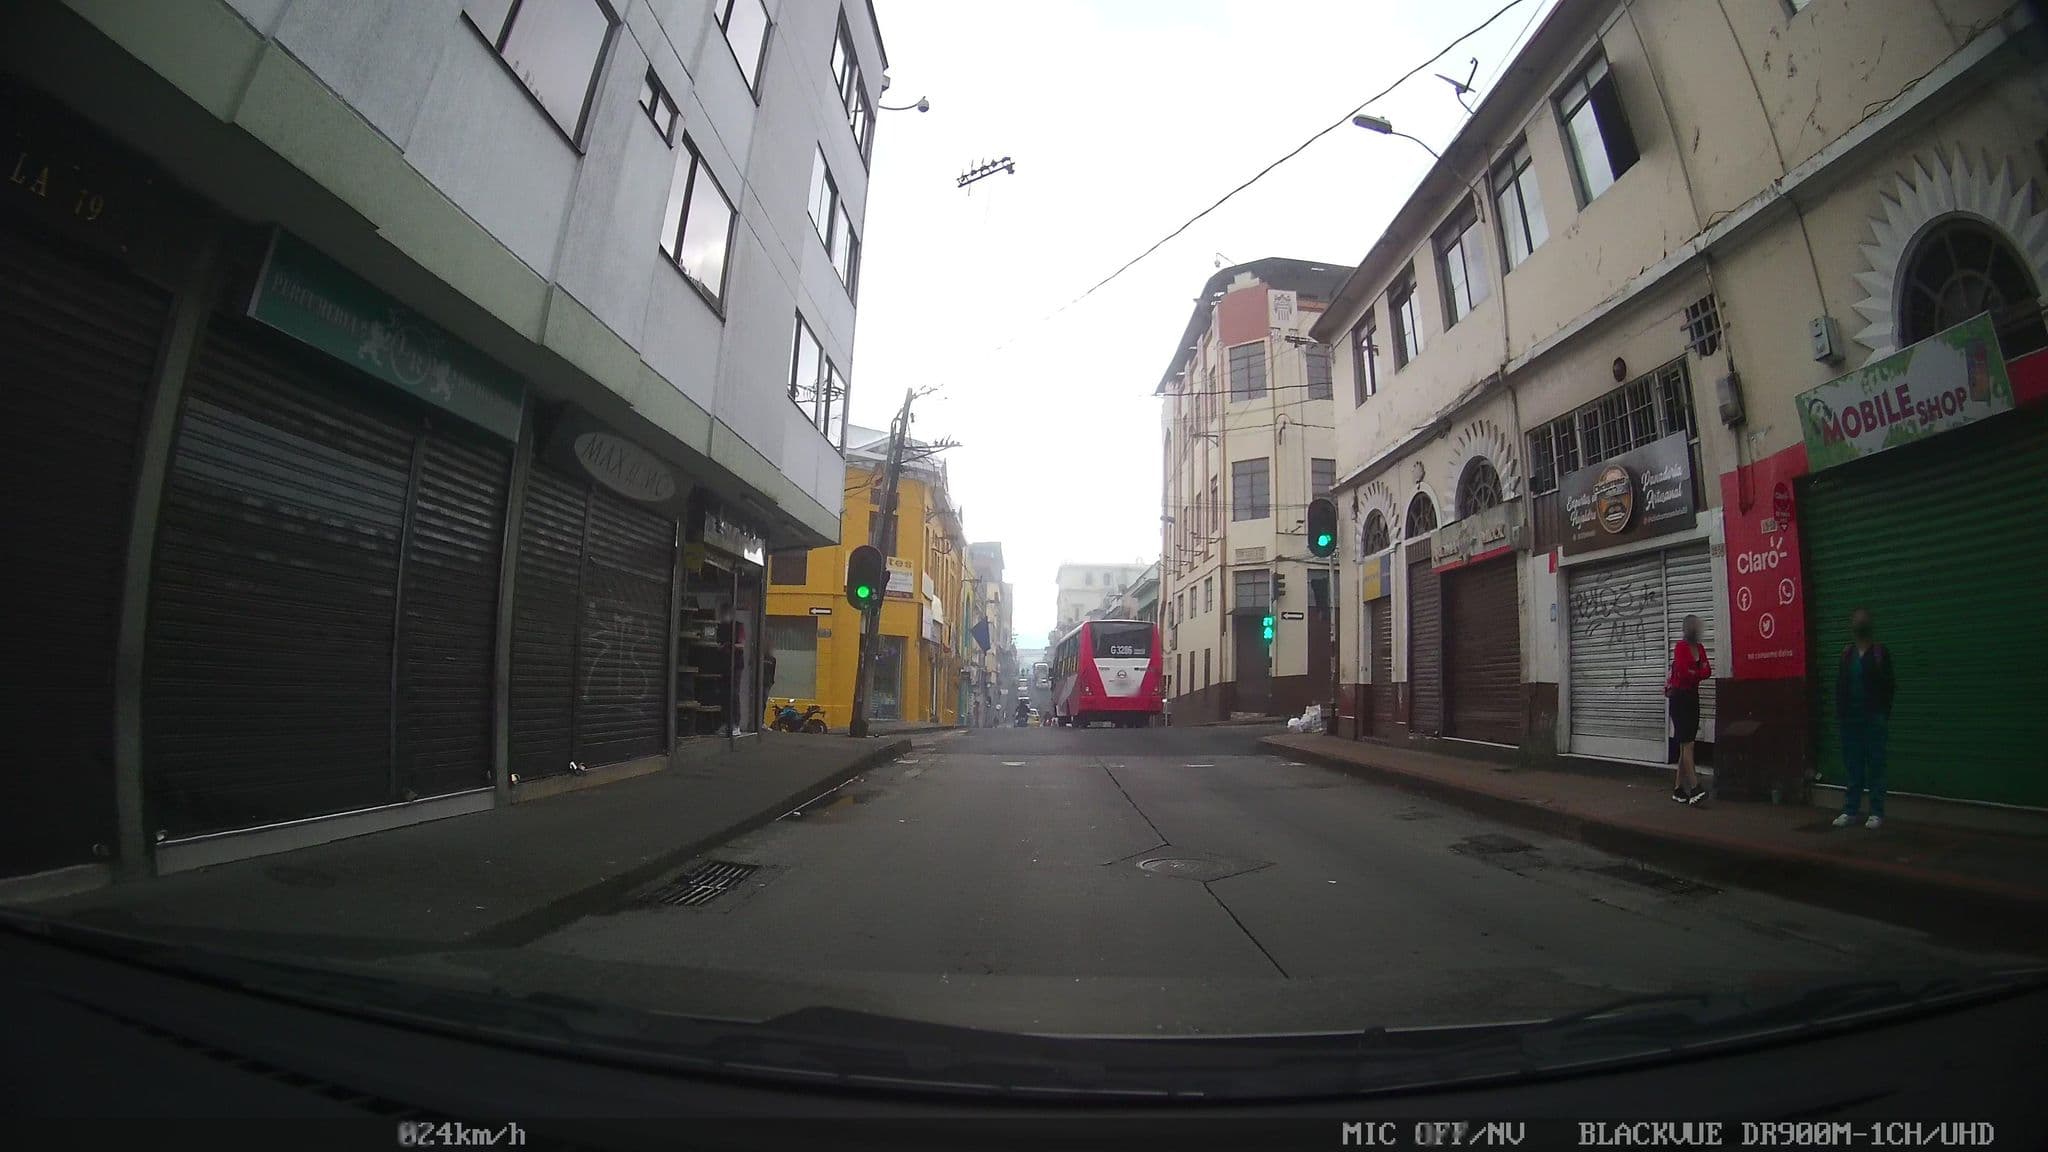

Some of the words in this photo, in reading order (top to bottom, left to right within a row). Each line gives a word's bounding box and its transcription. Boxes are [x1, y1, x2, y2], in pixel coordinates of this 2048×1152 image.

[1822, 383, 1916, 448] MOBILE
[1918, 387, 1967, 426] SHOP
[1737, 549, 1779, 574] Claro
